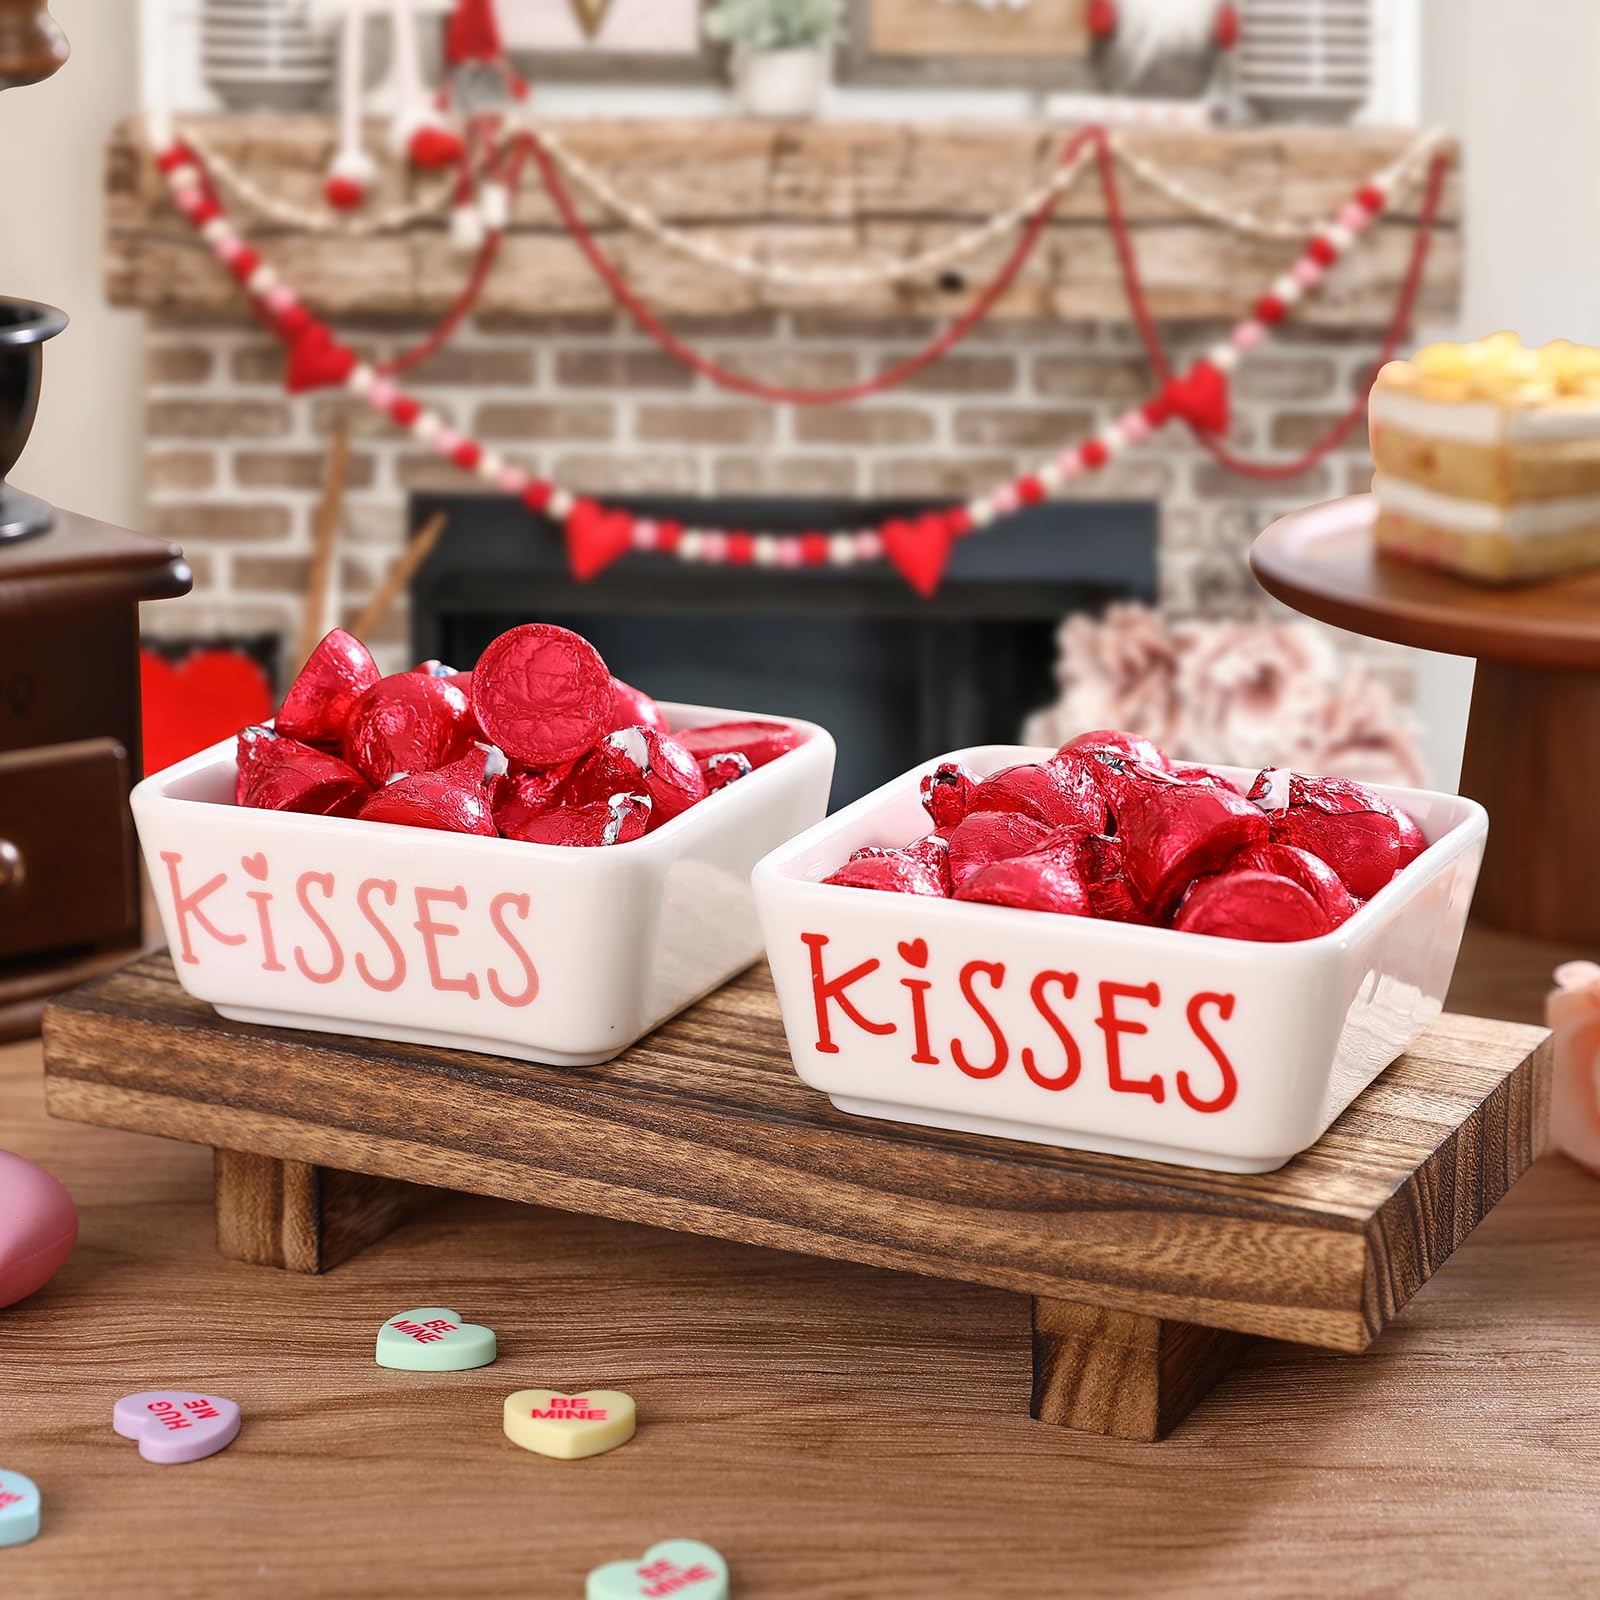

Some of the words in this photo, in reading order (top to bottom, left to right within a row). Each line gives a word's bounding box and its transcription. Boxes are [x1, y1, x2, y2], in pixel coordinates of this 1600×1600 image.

[388, 1319, 446, 1344] MINE
[422, 1319, 459, 1333] BE
[183, 1398, 222, 1420] ME
[550, 1397, 590, 1409] BE
[146, 1400, 193, 1431] HUG
[530, 1408, 609, 1421] MINE
